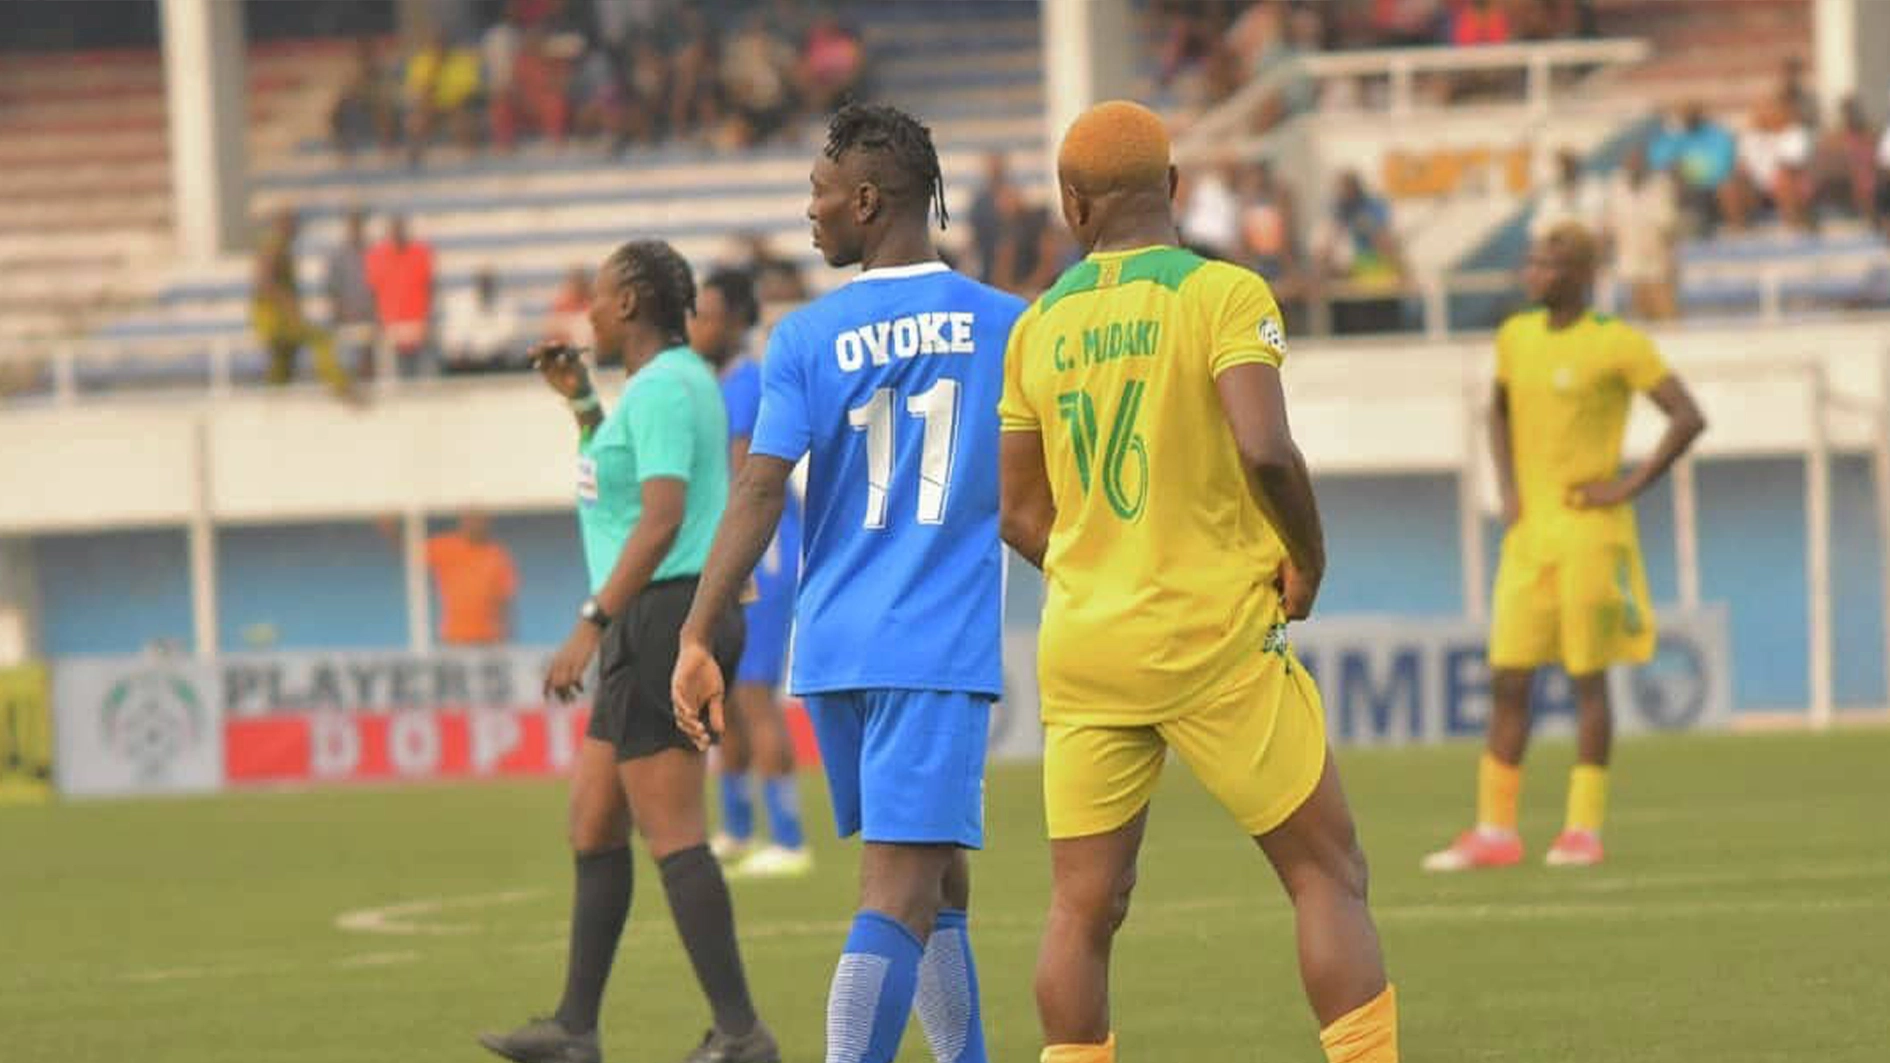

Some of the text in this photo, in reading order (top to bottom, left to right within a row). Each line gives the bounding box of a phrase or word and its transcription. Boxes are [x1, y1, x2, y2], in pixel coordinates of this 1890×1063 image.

[835, 313, 974, 372] OVOKE
[847, 378, 962, 530] 11
[1058, 379, 1150, 524] 16
[223, 659, 514, 709] PLAYERS
[312, 708, 578, 776] DOPI
